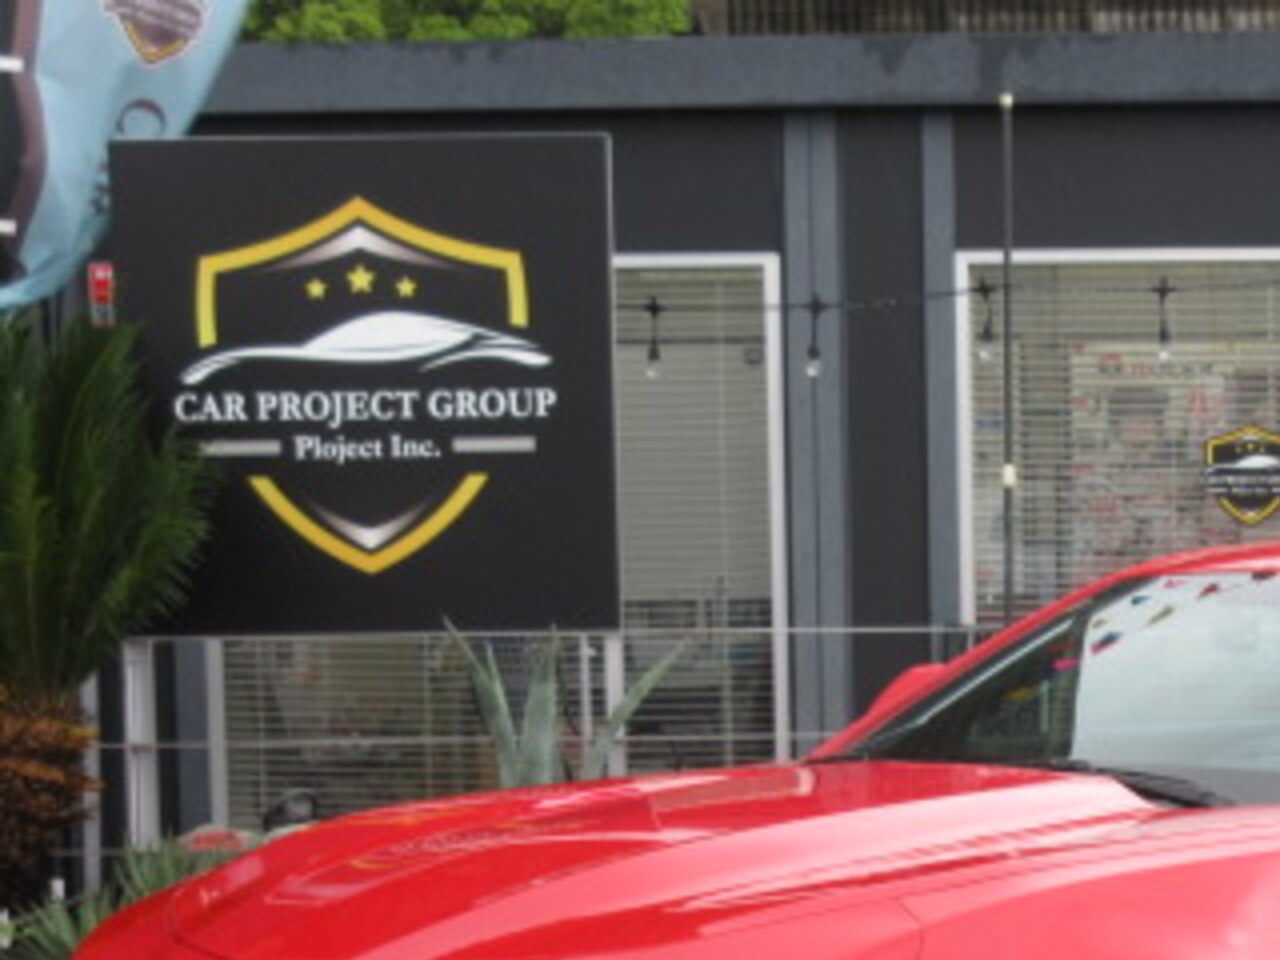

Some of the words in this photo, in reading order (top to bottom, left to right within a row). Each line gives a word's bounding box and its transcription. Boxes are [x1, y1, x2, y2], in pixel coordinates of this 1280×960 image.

[173, 390, 248, 423] CAR
[257, 390, 419, 428] PROJECT
[427, 386, 558, 419] GROUP
[293, 434, 383, 465] Ploject
[390, 434, 441, 459] Inc.
